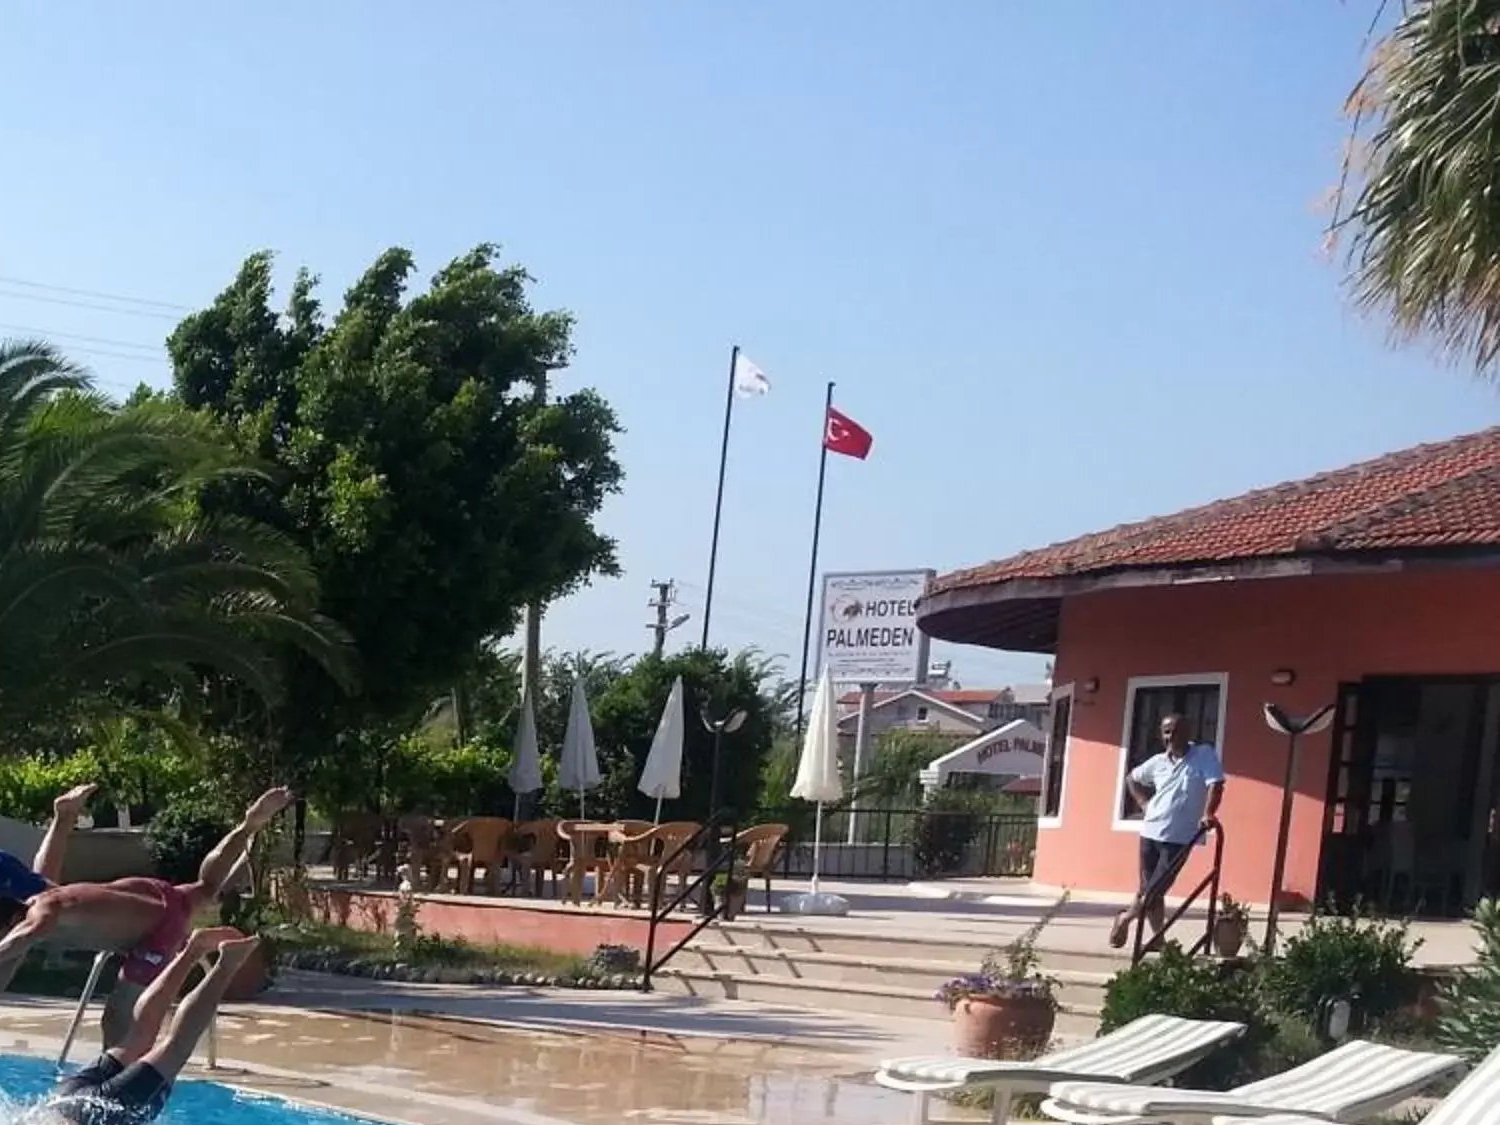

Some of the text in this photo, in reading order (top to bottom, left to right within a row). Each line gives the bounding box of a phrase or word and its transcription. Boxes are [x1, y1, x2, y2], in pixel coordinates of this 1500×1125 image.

[865, 599, 915, 617] HOTEL
[826, 627, 915, 648] PALMEDEN
[977, 739, 1011, 765] HOTEL
